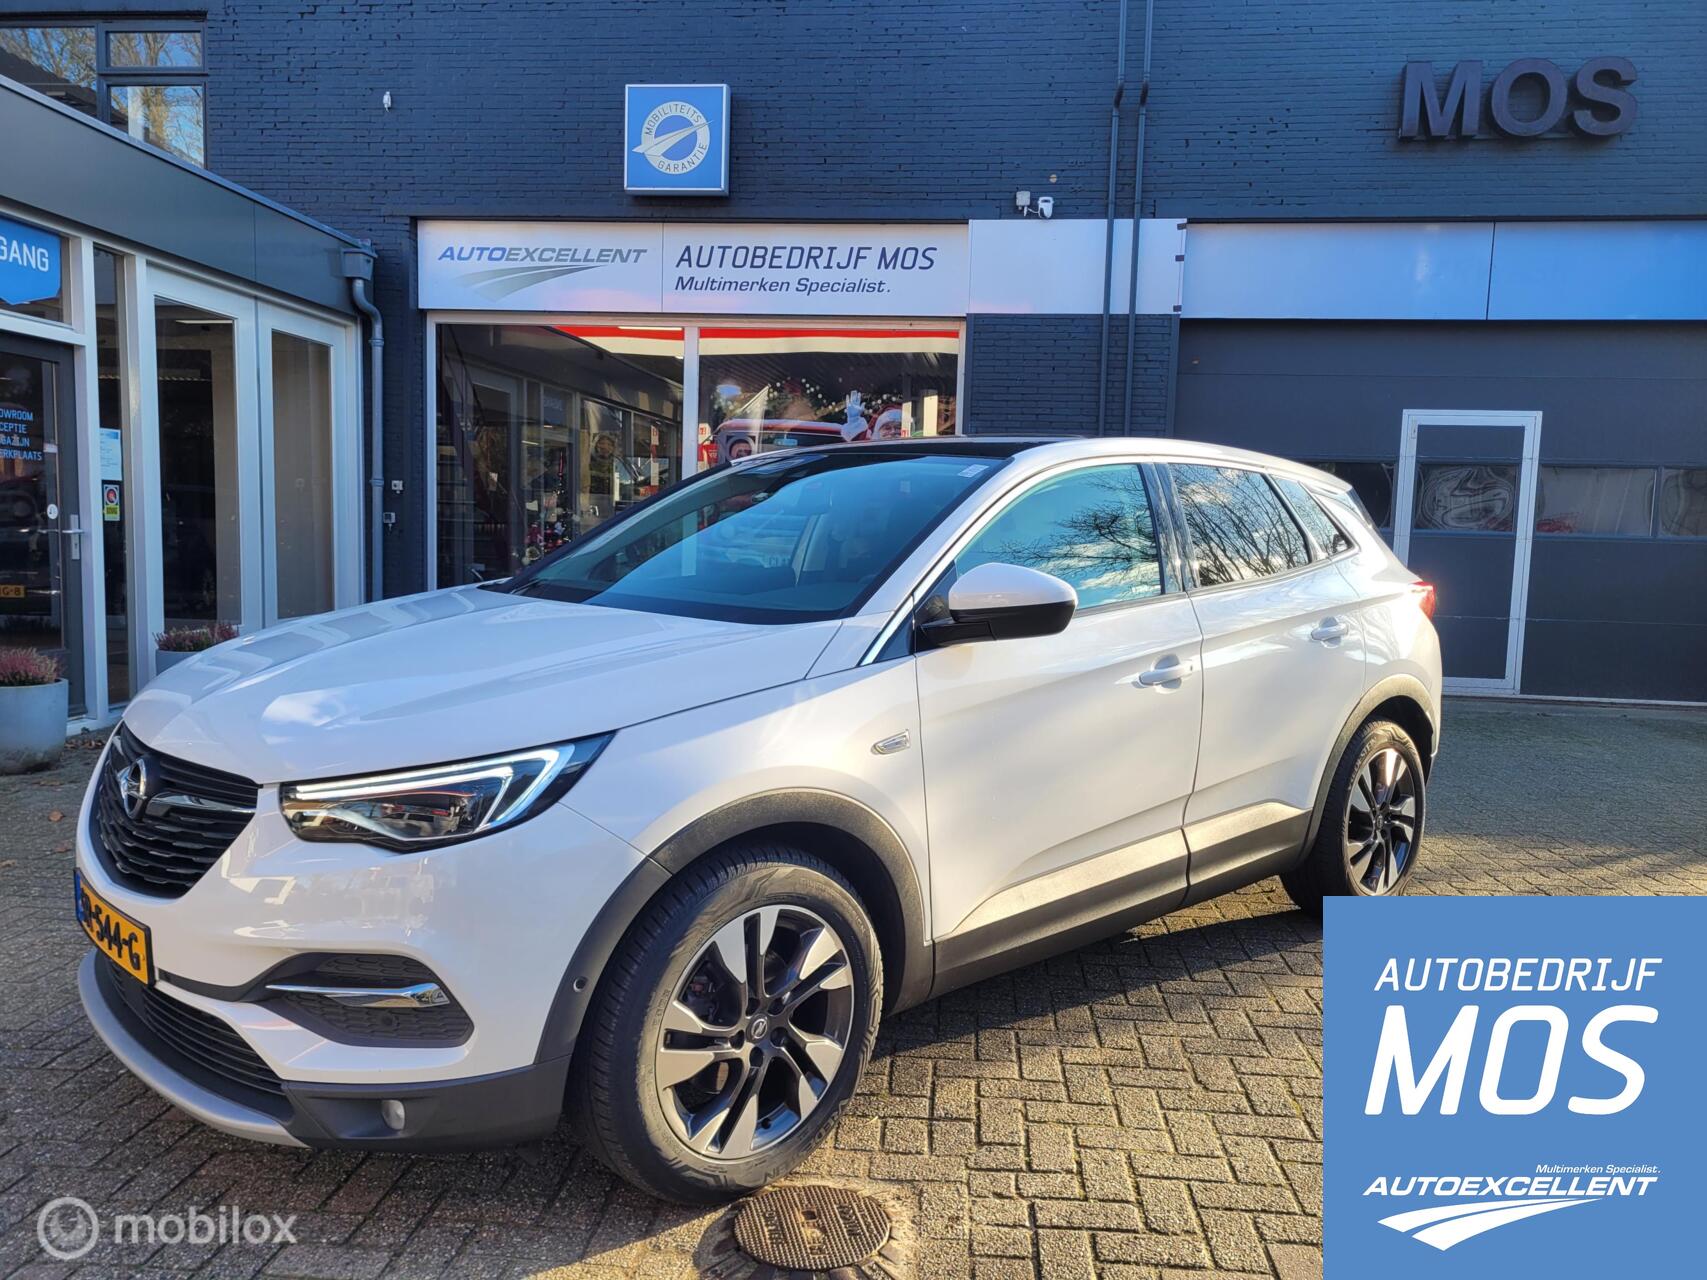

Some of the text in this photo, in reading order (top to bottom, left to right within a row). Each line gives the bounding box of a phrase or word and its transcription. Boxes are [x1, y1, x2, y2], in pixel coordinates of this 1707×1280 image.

[1399, 55, 1638, 138] MOS
[644, 103, 702, 136] MOBILITEITS
[657, 143, 707, 173] GARANTIE
[438, 246, 648, 264] AUTOEXCELLENT
[676, 245, 938, 270] AUTOBEDRIJF MOS
[675, 276, 891, 296] Multimerken Specialist.
